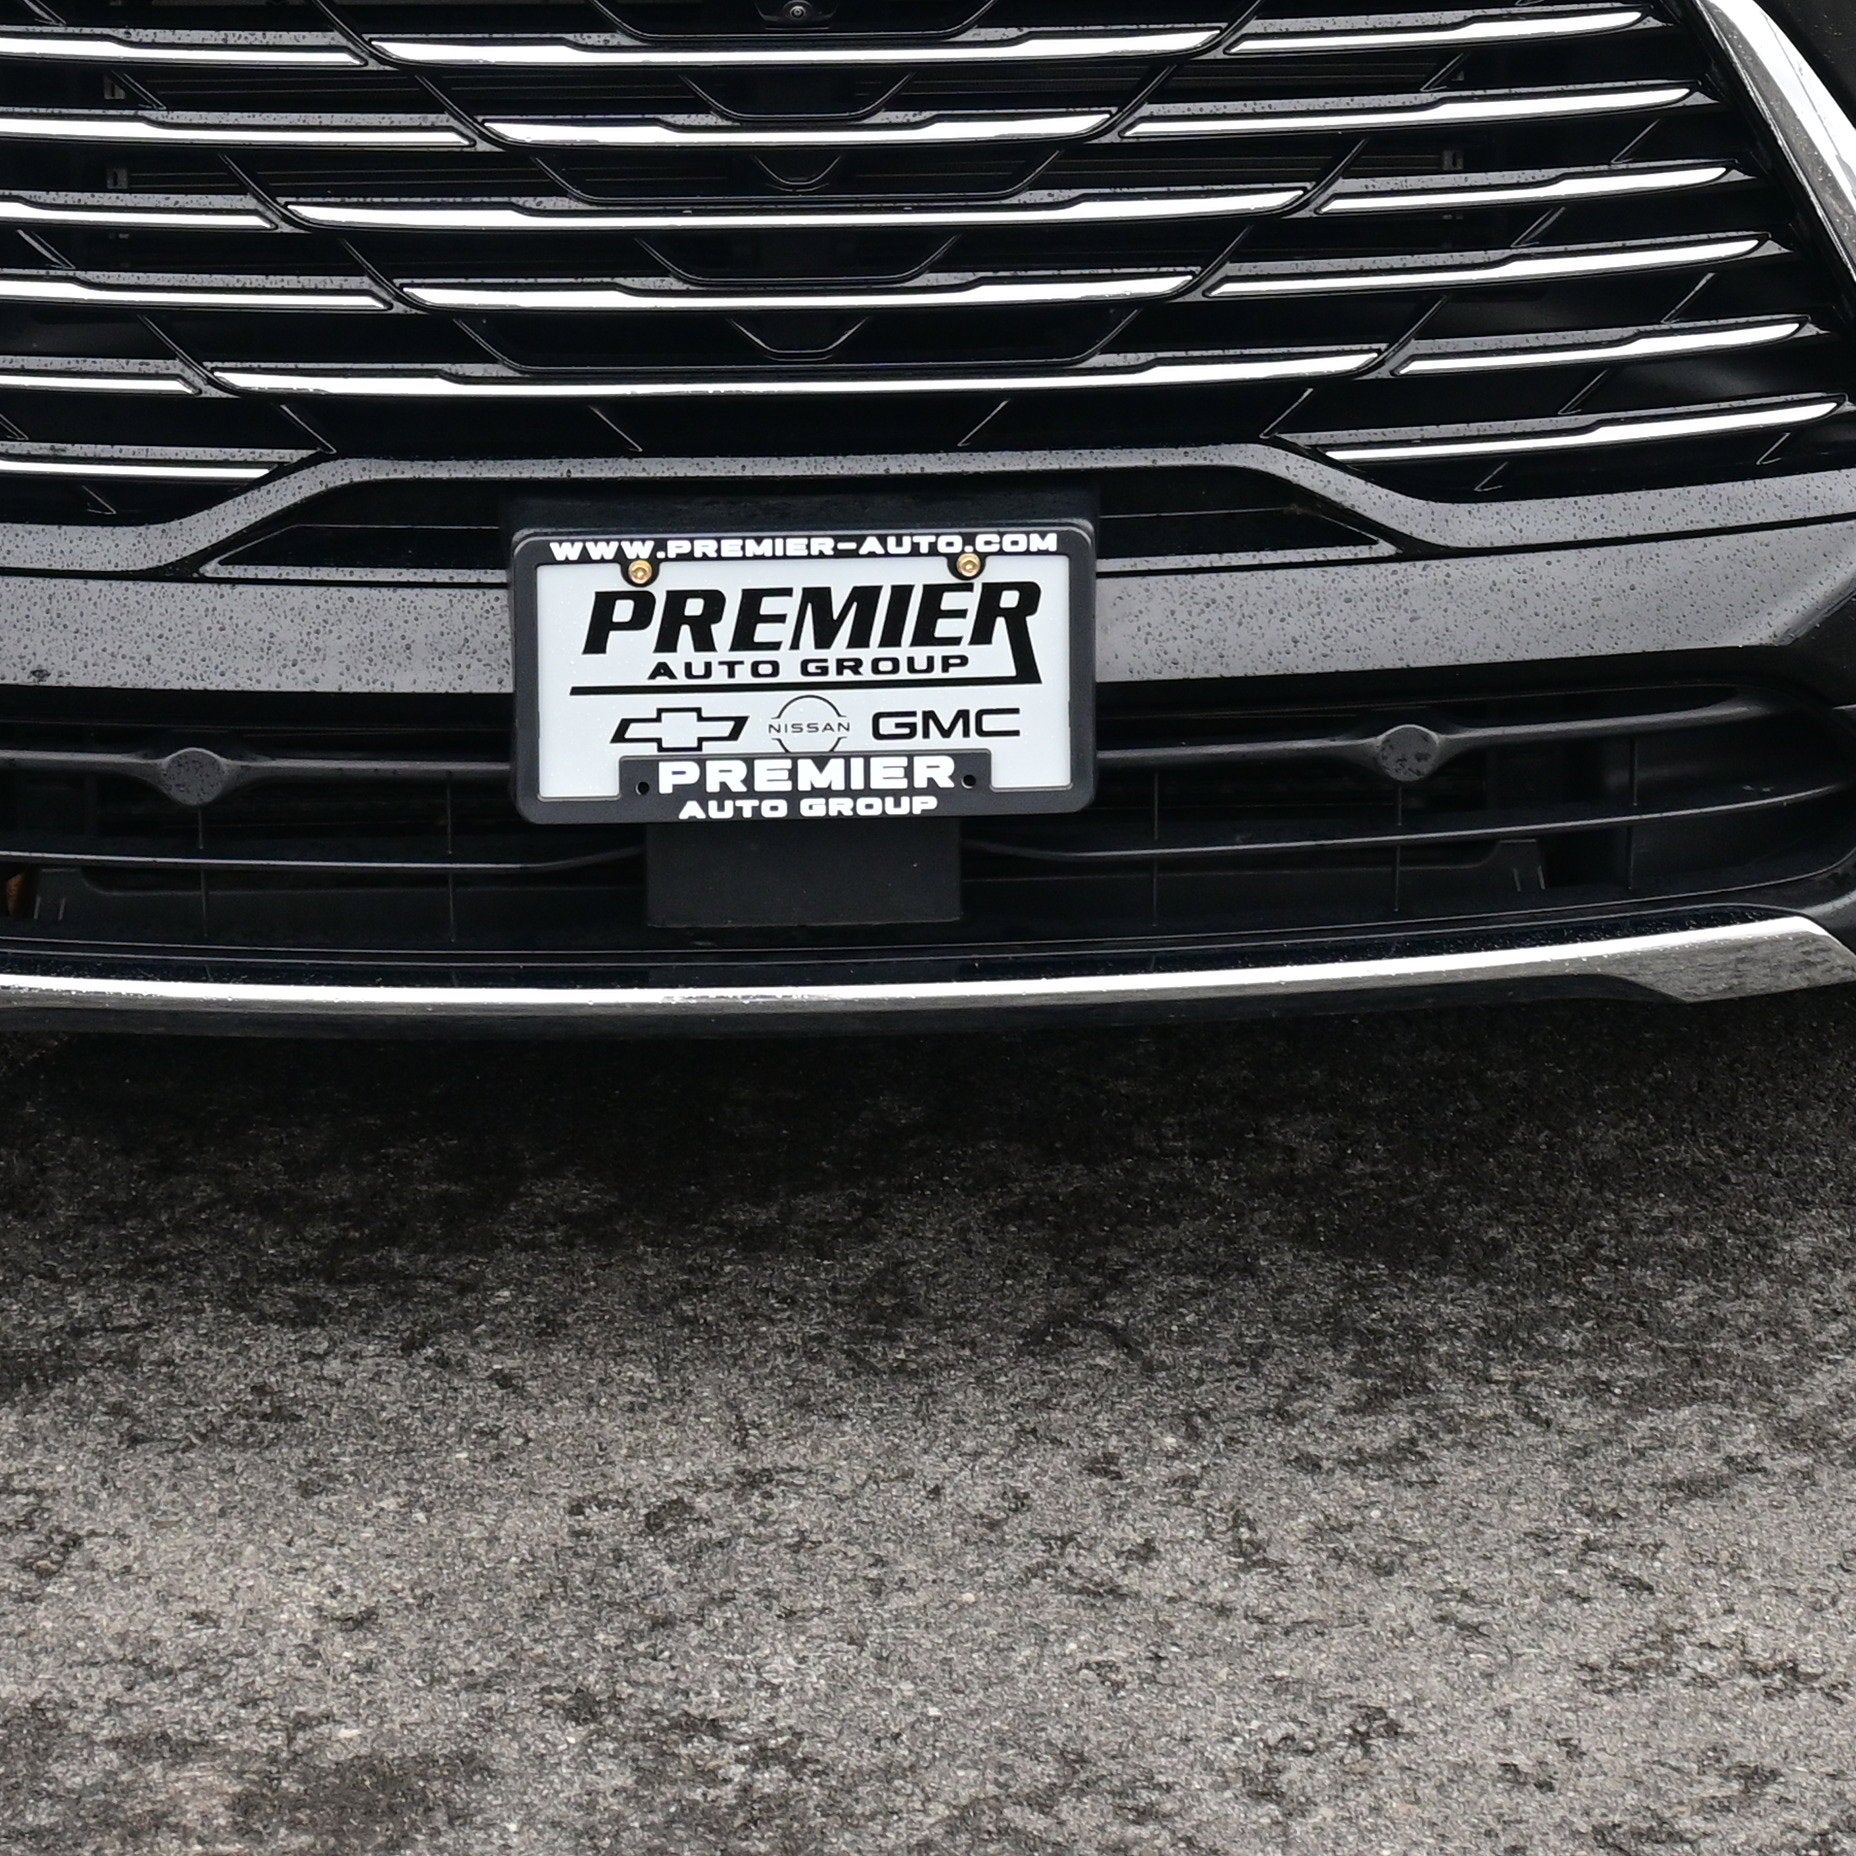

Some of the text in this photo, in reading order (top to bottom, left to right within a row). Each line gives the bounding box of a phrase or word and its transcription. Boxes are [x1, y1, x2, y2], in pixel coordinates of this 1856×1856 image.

[549, 532, 1058, 561] WWW.PREMIER-AUTO.COM
[581, 581, 1042, 684] PREMIER
[647, 654, 969, 680] AUTO GROUP
[768, 707, 1020, 741] NISSAN GMC
[658, 755, 955, 794] PREMIER
[678, 795, 938, 820] AUTO GROUP
